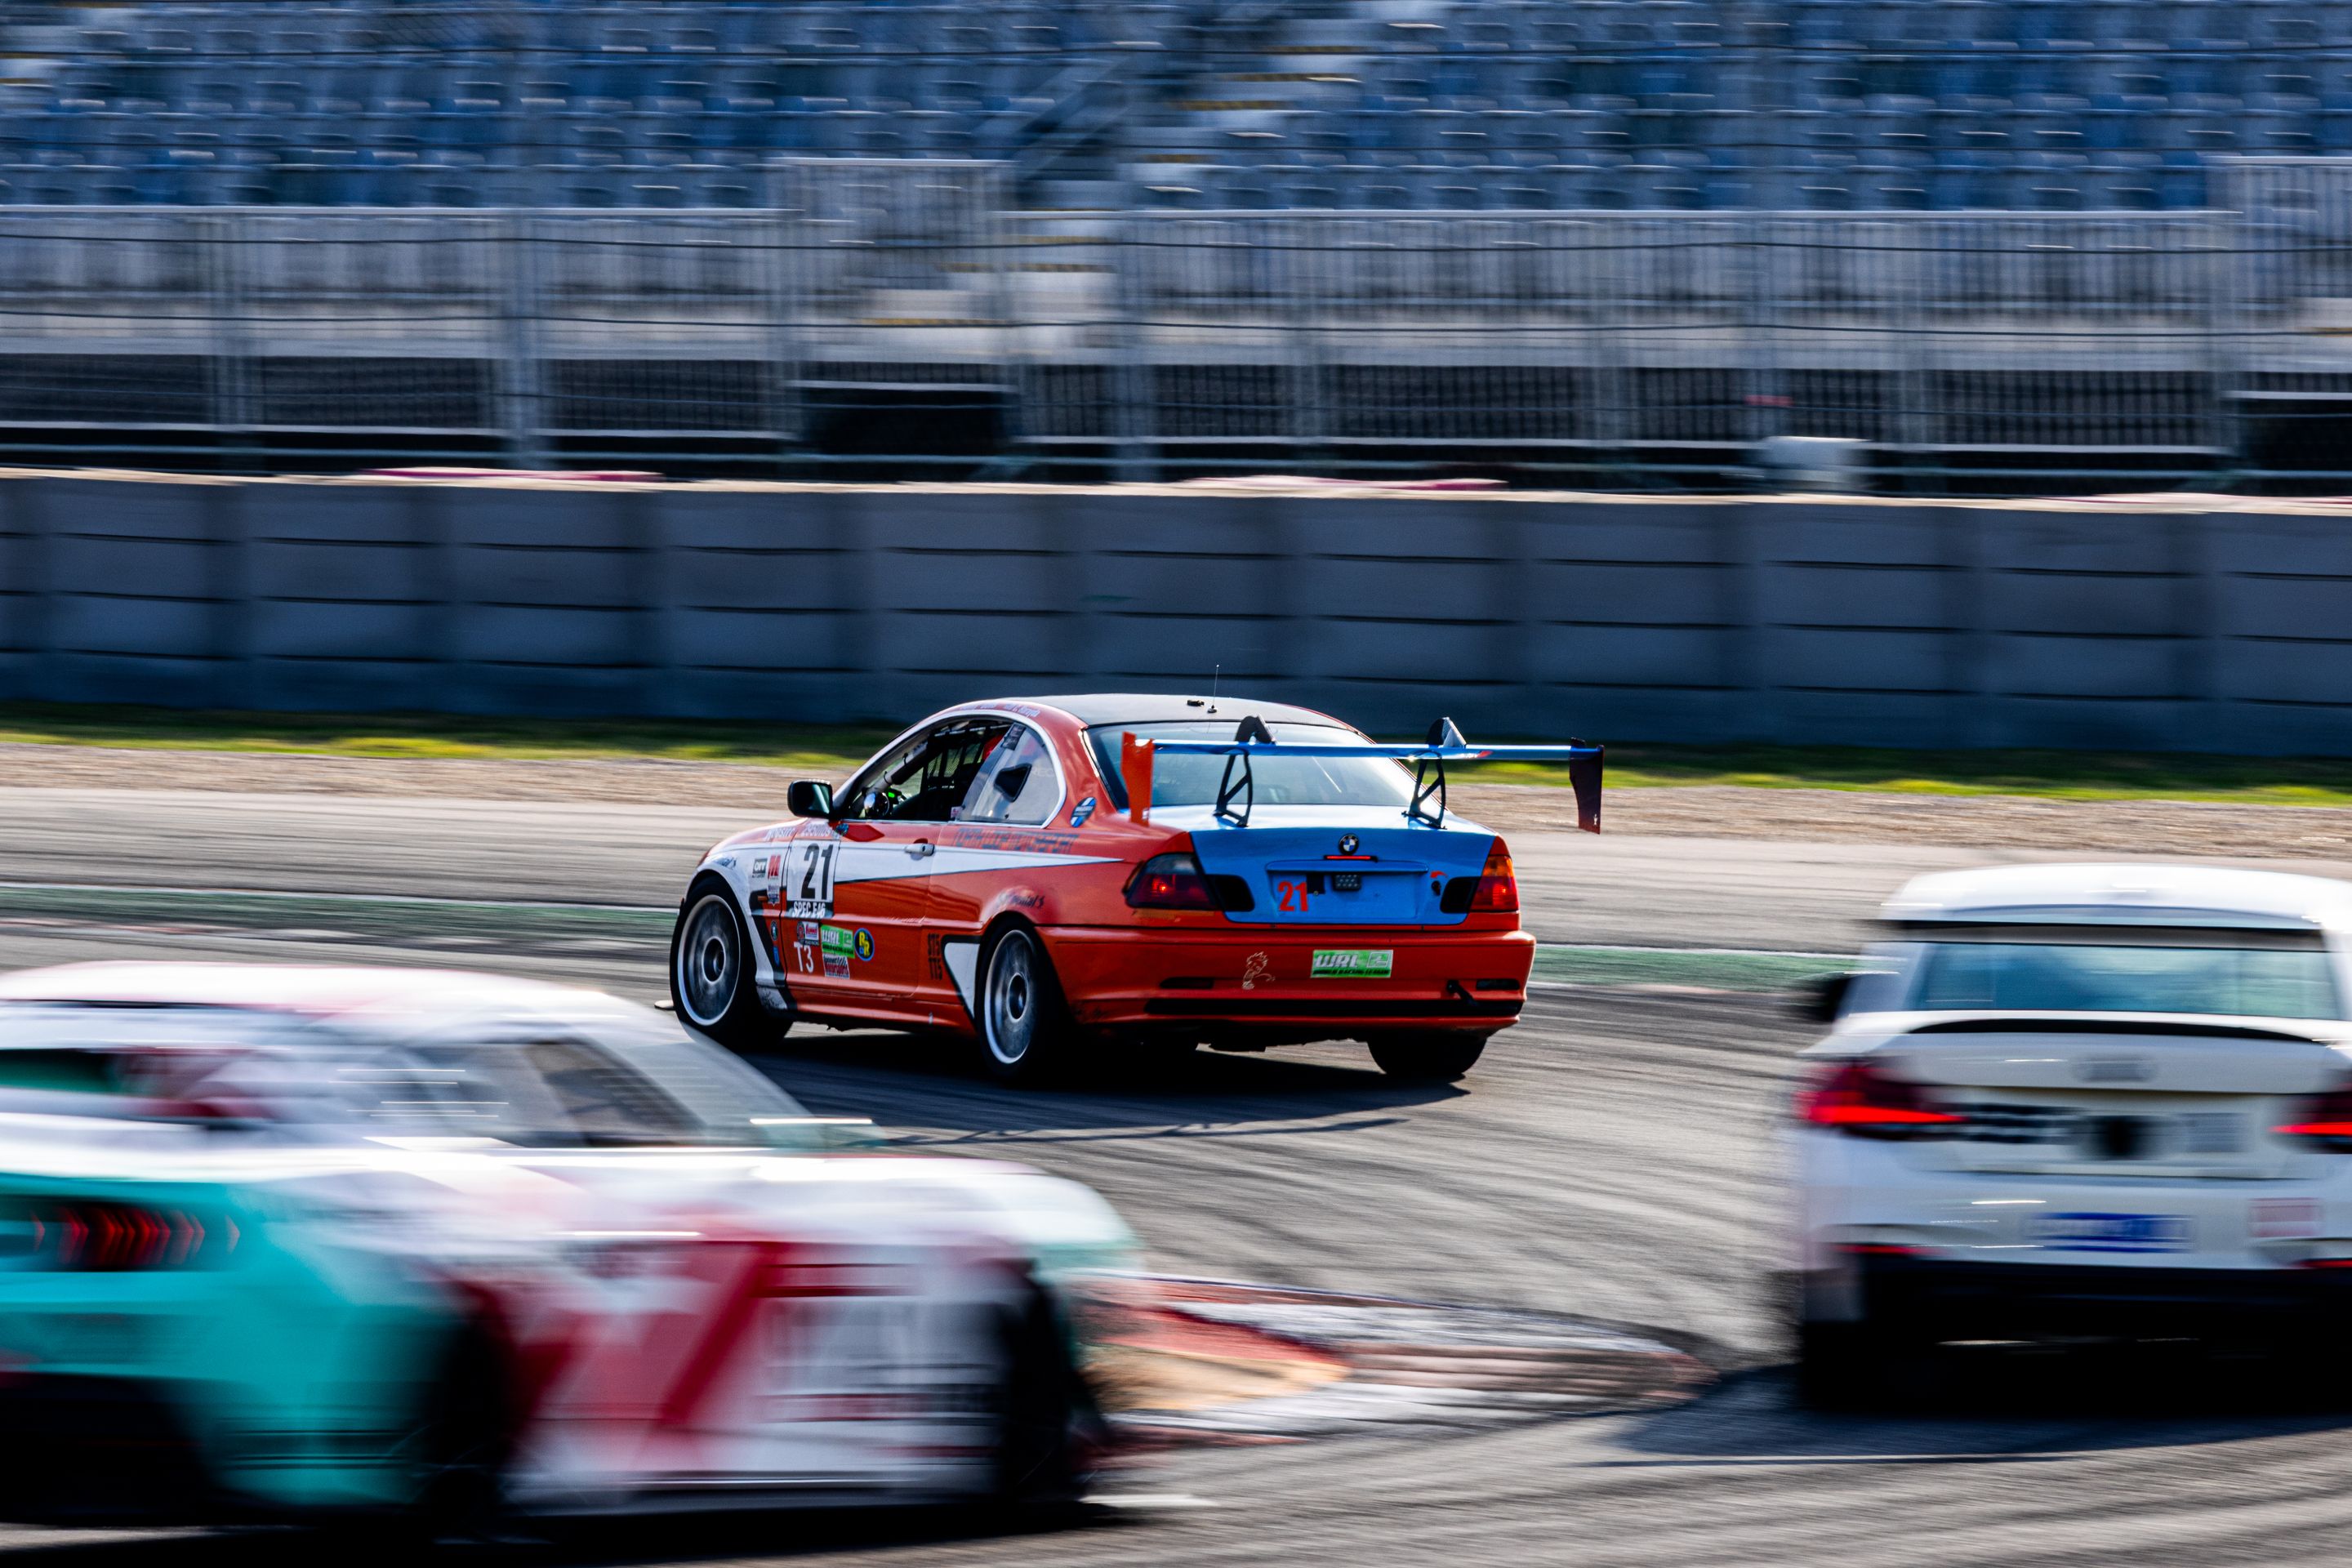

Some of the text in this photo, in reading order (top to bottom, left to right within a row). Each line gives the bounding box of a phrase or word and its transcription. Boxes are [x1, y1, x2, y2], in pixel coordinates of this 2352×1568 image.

[800, 843, 834, 900] 21
[1278, 880, 1308, 911] 21
[792, 901, 826, 918] SPEC E46
[822, 929, 840, 945] WRL
[794, 941, 814, 973] T3
[1315, 954, 1358, 968] WRL
